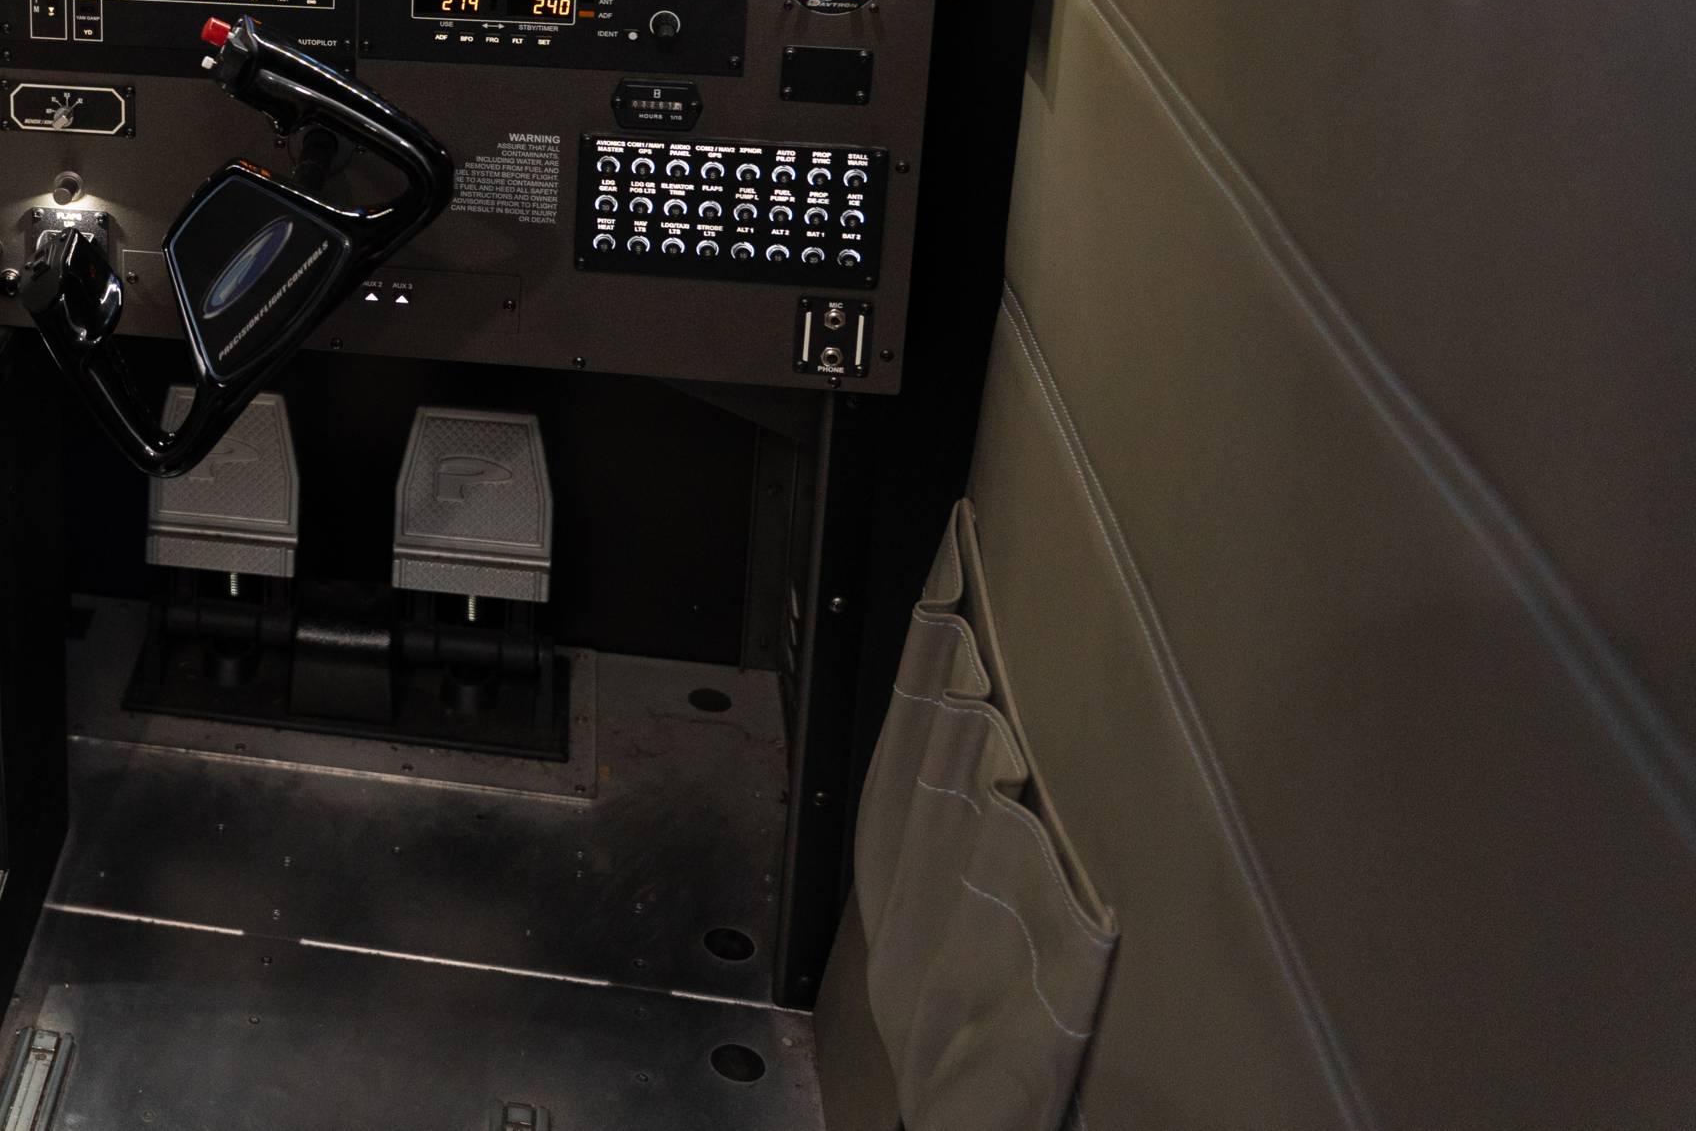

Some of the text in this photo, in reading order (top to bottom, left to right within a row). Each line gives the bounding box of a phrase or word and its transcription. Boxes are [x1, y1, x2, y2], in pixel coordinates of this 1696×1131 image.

[518, 24, 559, 33] STBY/TIMER
[597, 30, 619, 38] IDENT
[297, 37, 338, 47] AUTOPILOT
[509, 133, 560, 144] WARNING
[661, 182, 694, 190] ELEVATOR
[817, 365, 844, 374] PHONE
